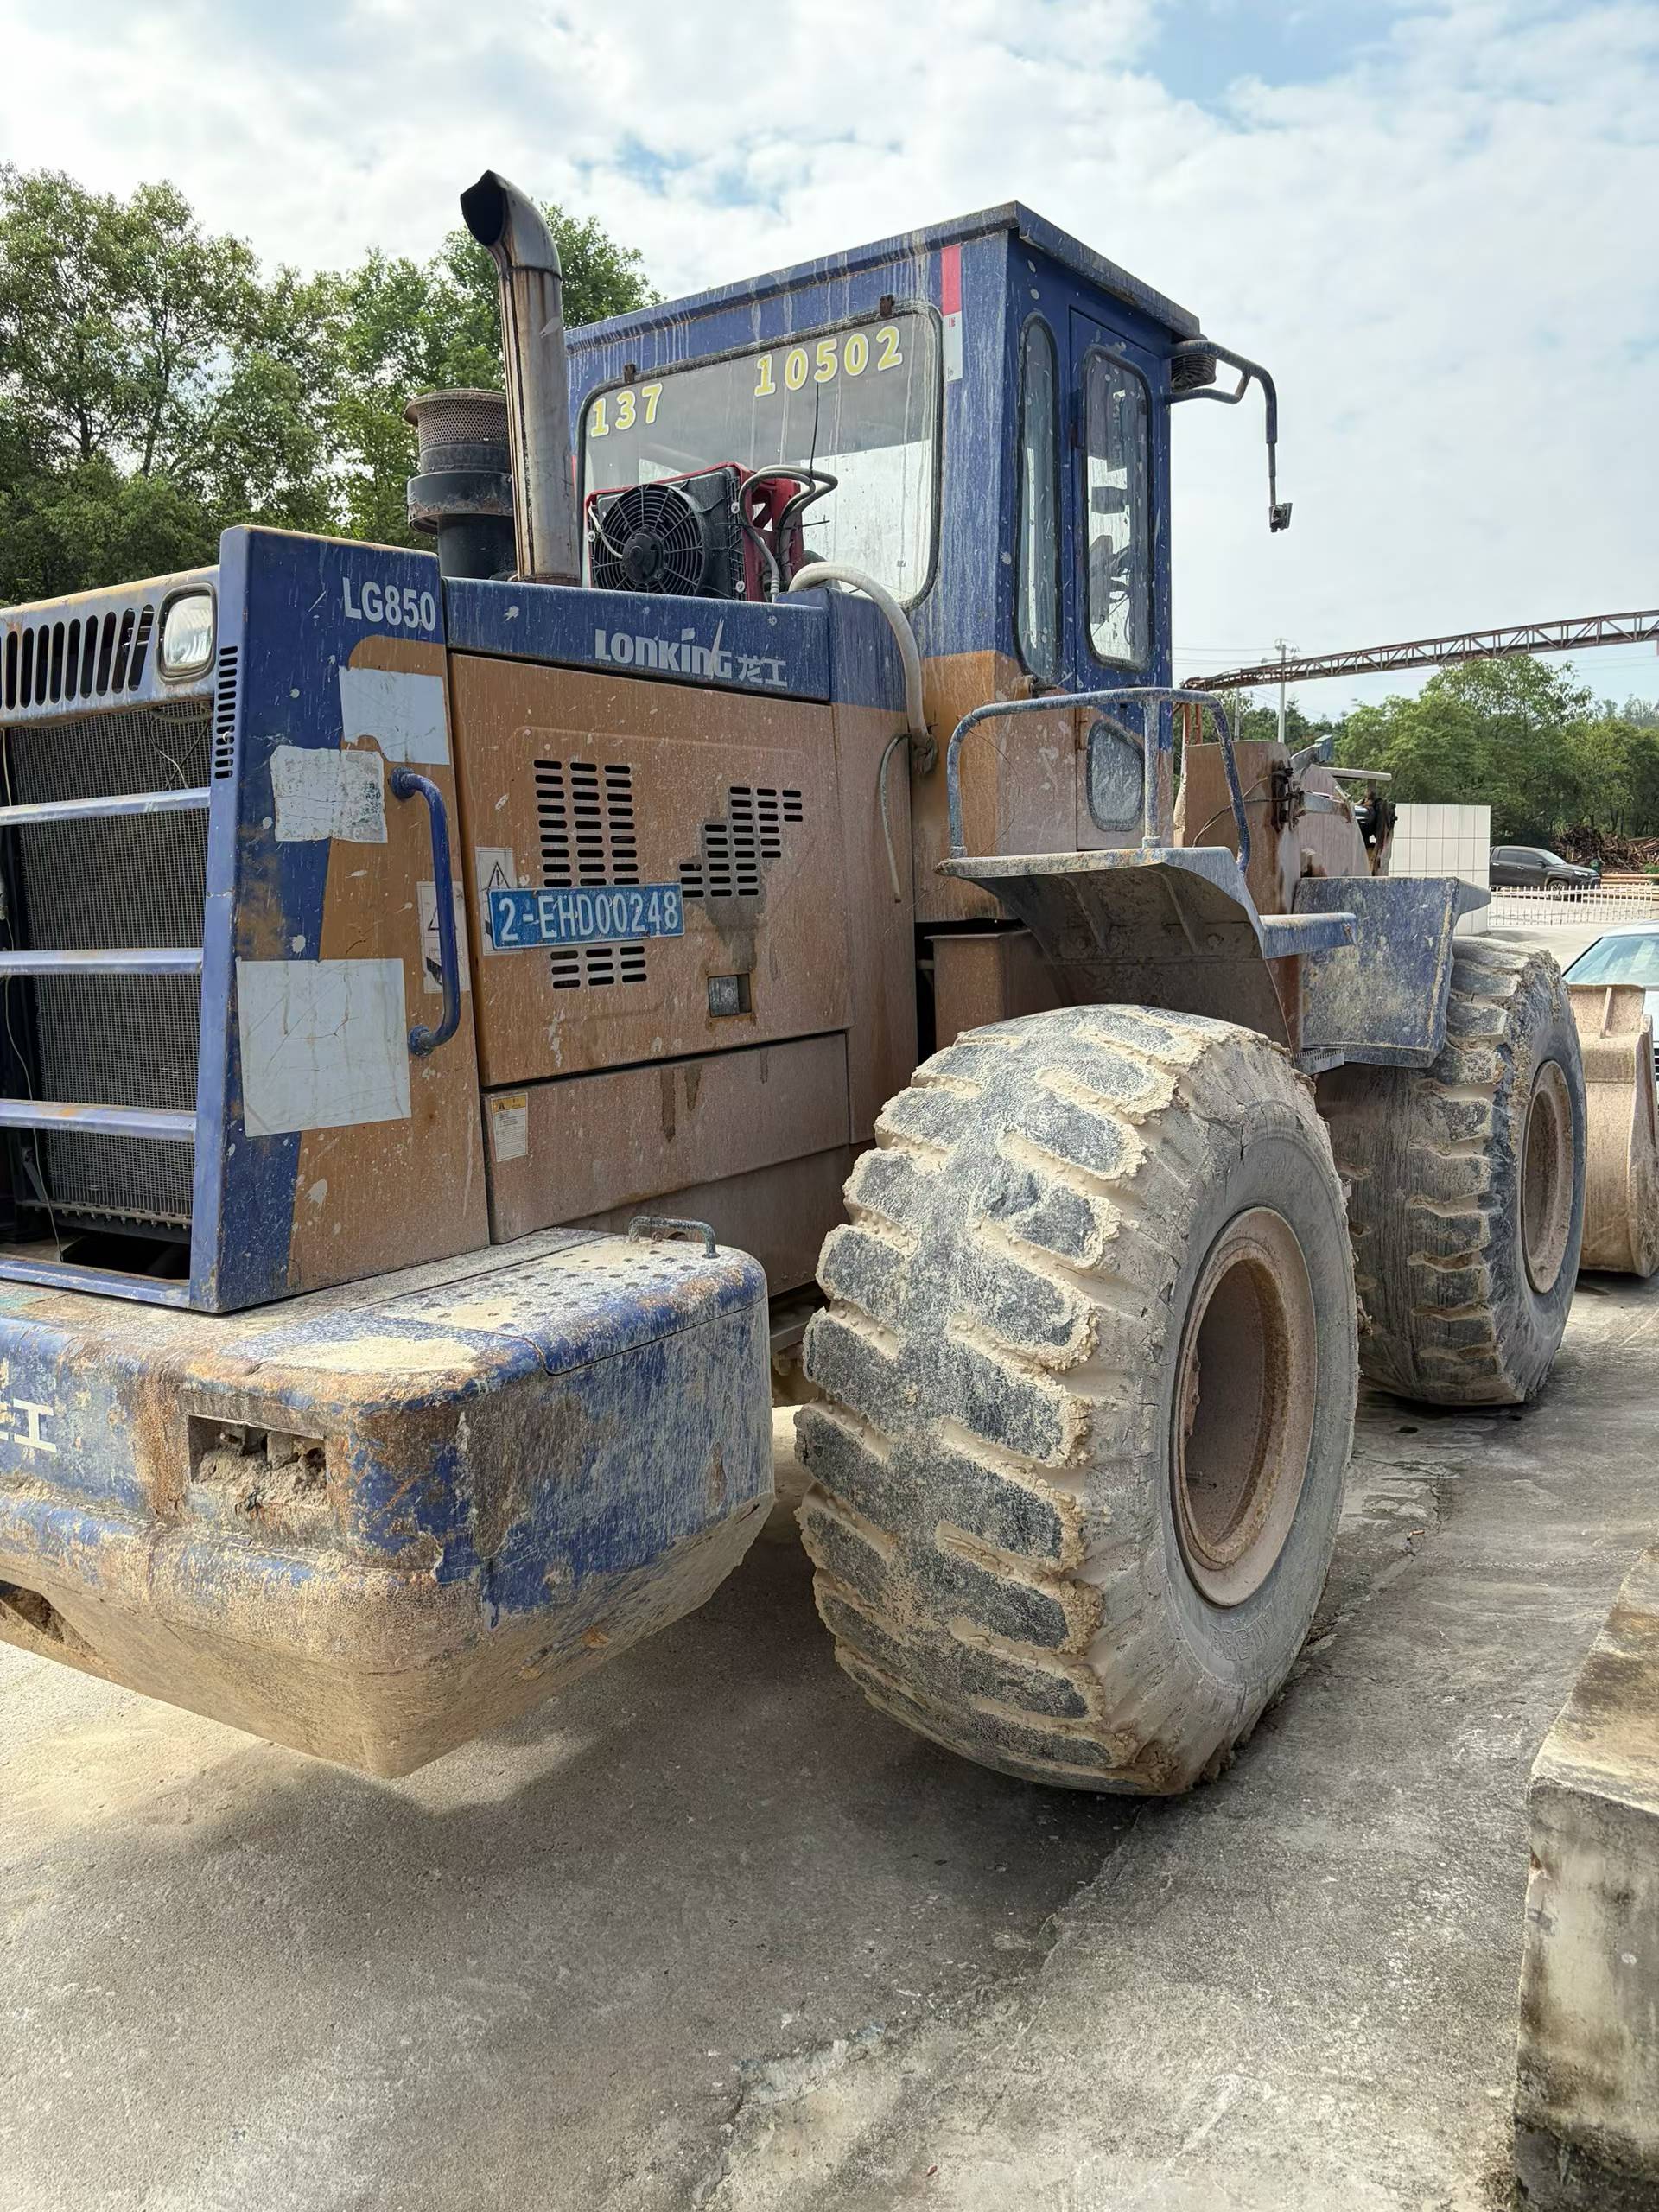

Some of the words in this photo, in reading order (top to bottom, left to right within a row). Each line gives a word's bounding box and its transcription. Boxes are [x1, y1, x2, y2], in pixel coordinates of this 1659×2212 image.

[590, 382, 663, 438] 137
[754, 325, 904, 397] 10502
[342, 576, 436, 632] LG850
[737, 653, 788, 688] 龙工
[499, 890, 679, 942] 2-EHD00248
[0, 1397, 57, 1453] 工
